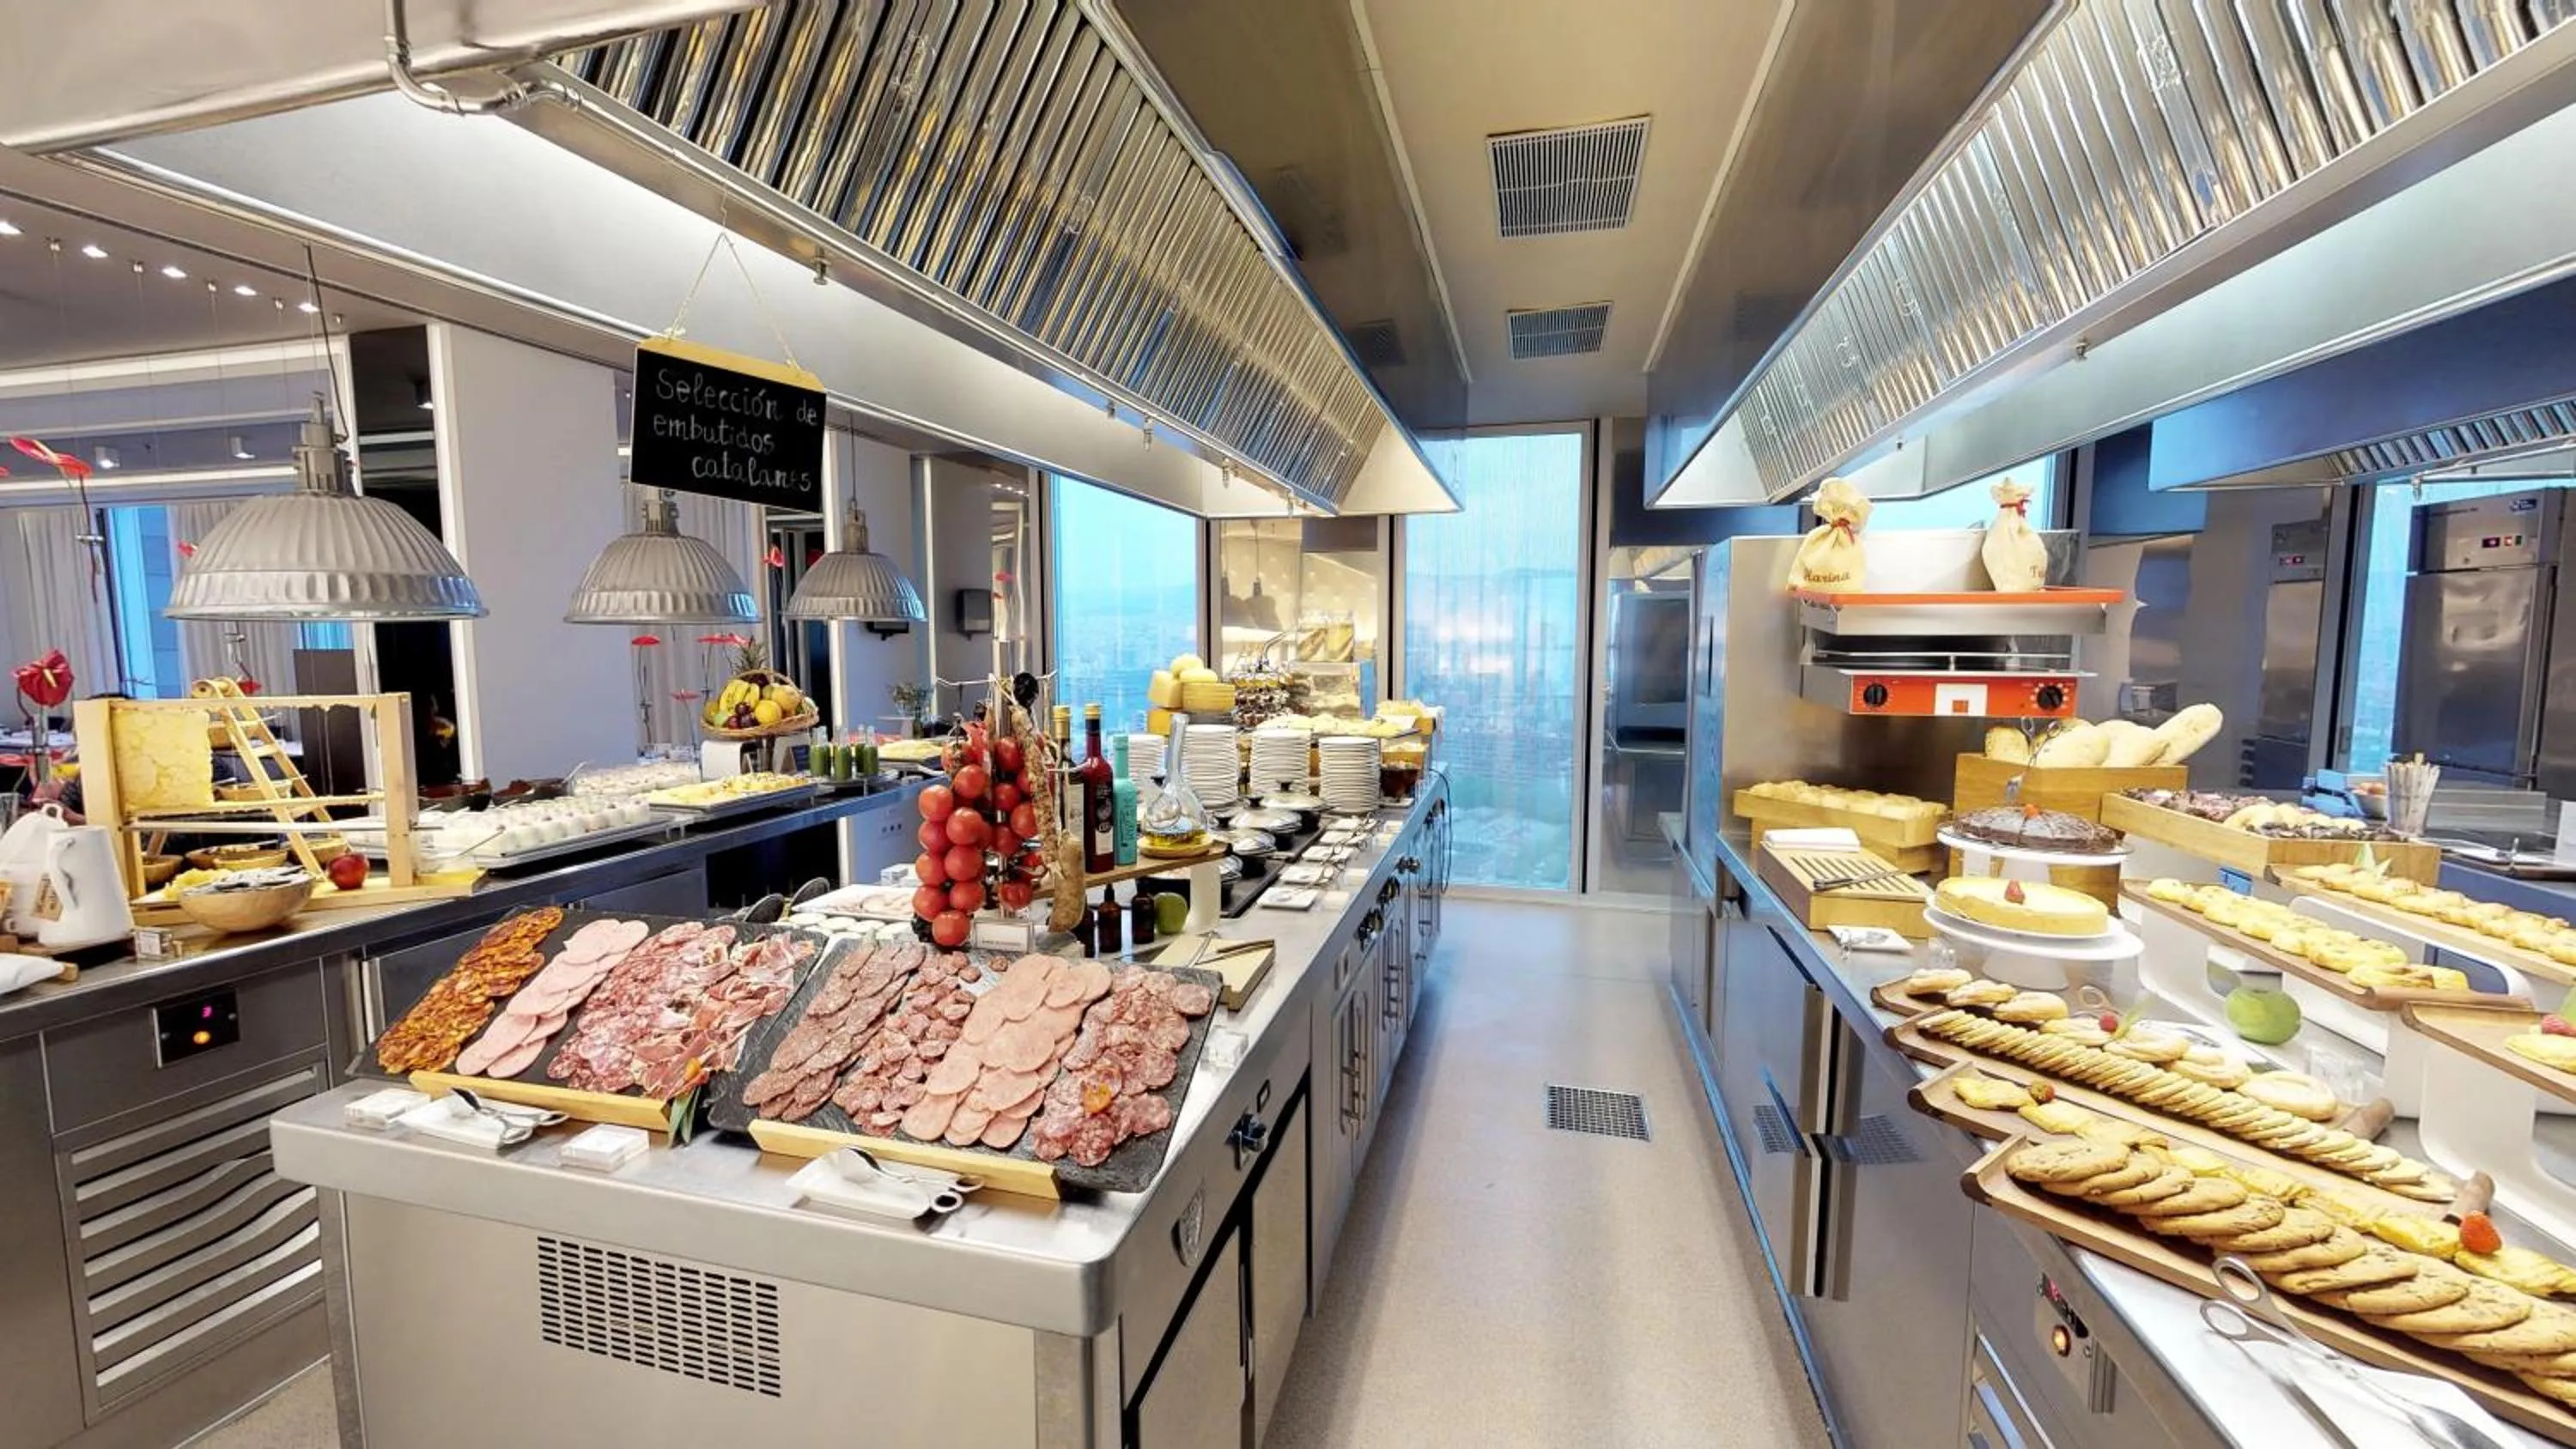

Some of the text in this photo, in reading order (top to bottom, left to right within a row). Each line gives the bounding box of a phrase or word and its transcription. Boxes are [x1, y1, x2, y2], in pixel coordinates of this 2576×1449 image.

[655, 367, 819, 427] Selección de
[653, 414, 776, 455] embutidos
[690, 451, 812, 493] catalanes
